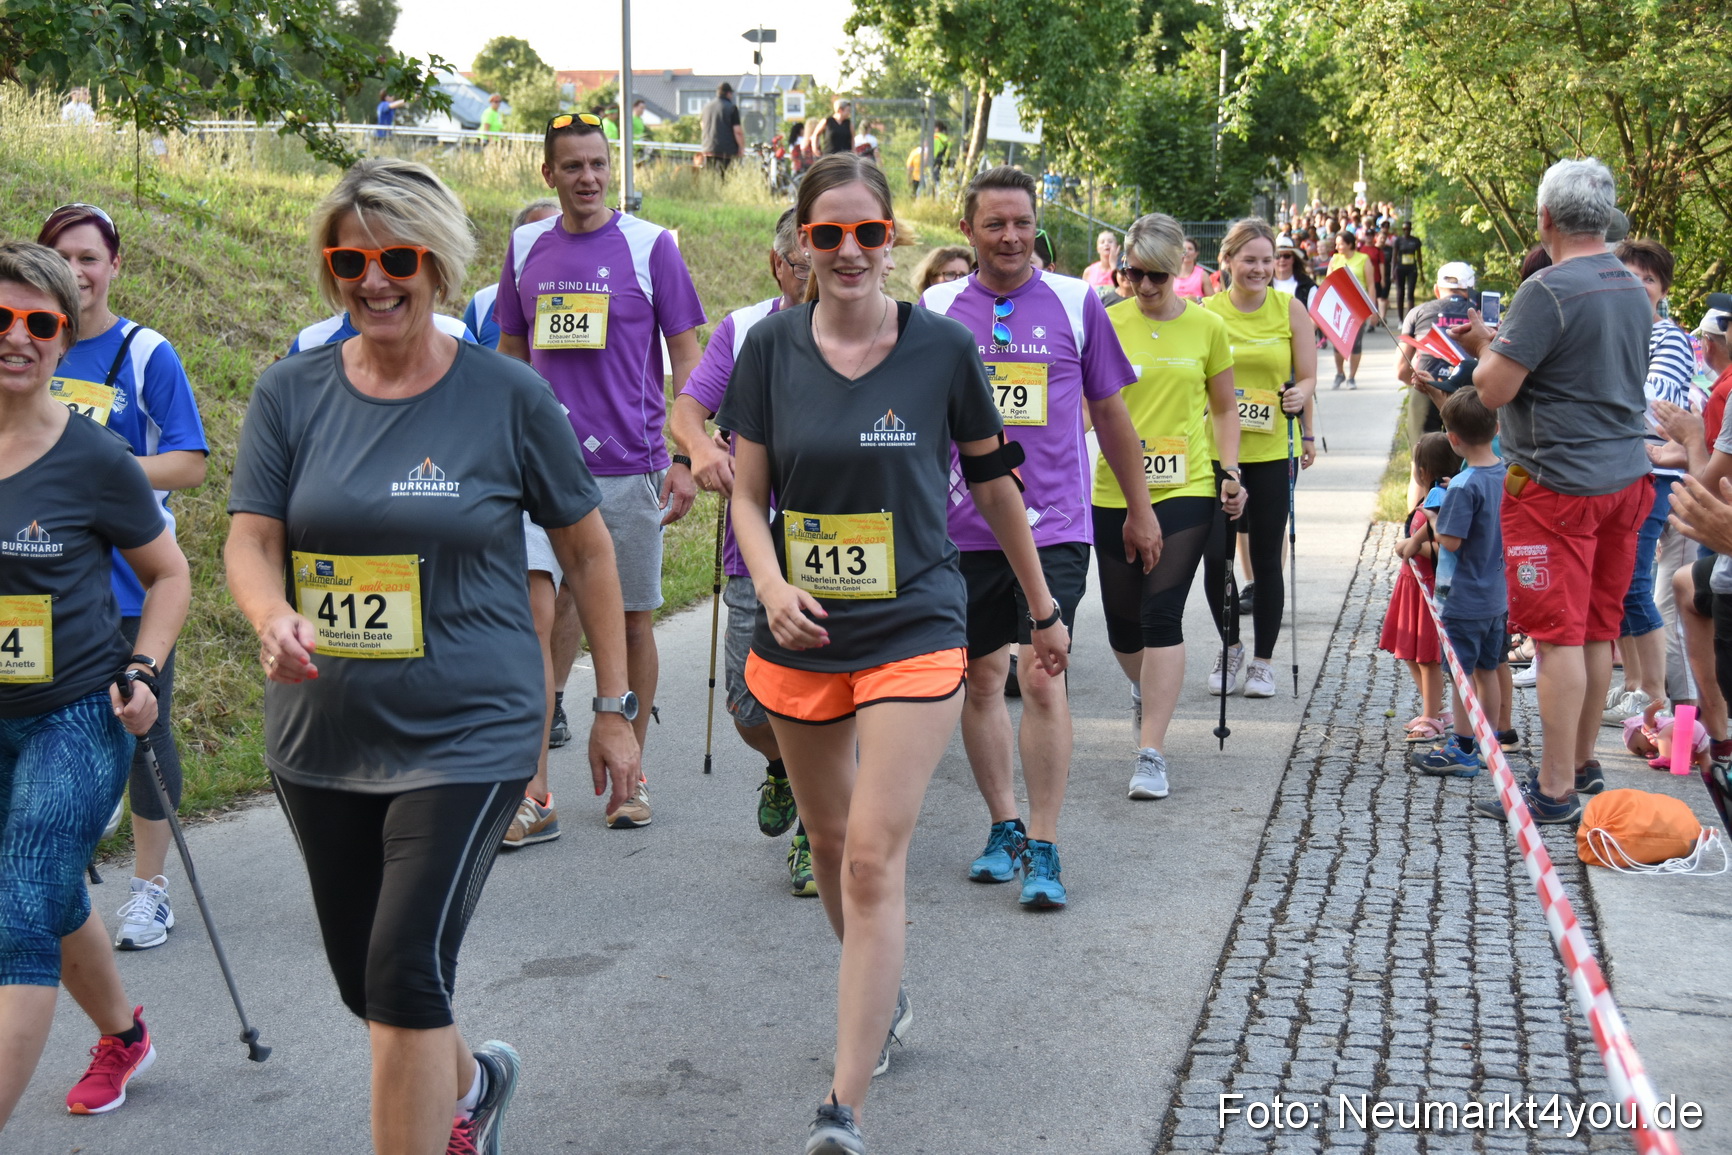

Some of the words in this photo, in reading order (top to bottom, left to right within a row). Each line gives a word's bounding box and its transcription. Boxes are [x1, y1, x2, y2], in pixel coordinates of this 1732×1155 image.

[539, 281, 555, 291] WIR
[558, 281, 583, 291] SIND
[586, 282, 612, 293] LILA.
[550, 313, 589, 334] 884
[1022, 344, 1051, 354] LILA.
[996, 385, 1028, 408] 79
[1238, 403, 1270, 421] 284
[860, 432, 917, 441] BURKHARDT
[1144, 455, 1177, 474] 201
[391, 481, 460, 492] BURKHARDT
[798, 529, 838, 540] firmenlauf
[843, 535, 864, 545] walk
[864, 536, 886, 544] 2019
[2, 541, 64, 552] BURKHARDT
[805, 545, 867, 576] 413
[308, 573, 353, 586] firmenlauf
[800, 574, 837, 585] Häberlein
[840, 576, 877, 585] Rebecca
[360, 580, 385, 592] walk
[385, 583, 411, 592] 2019
[813, 584, 841, 592] Burkhardt
[318, 592, 388, 629] 412
[21, 619, 44, 627] 2019
[319, 628, 361, 641] Häberlein
[363, 631, 393, 641] Beate
[328, 640, 358, 648] Burkhardt
[5, 660, 36, 668] Anette
